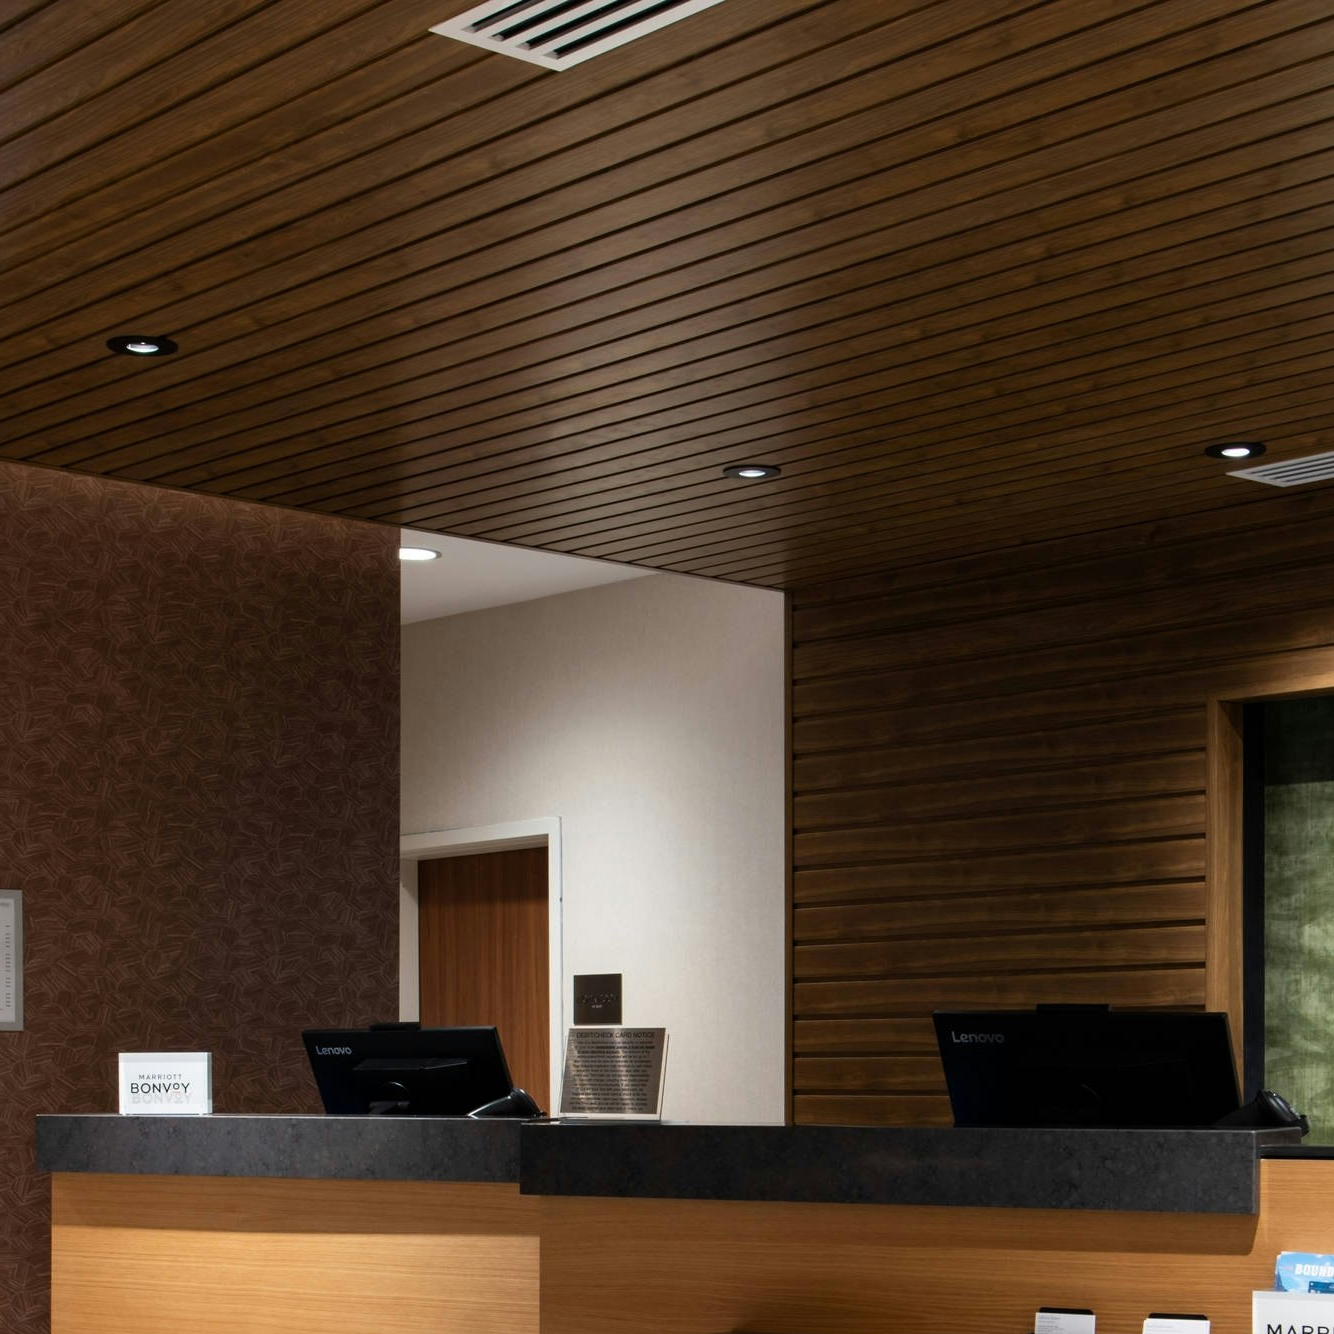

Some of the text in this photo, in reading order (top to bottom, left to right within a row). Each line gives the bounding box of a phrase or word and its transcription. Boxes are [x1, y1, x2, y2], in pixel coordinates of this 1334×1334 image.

[633, 1031, 655, 1039] NOTICE
[951, 1031, 1004, 1043] Lenovo
[315, 1045, 352, 1055] Lenovo
